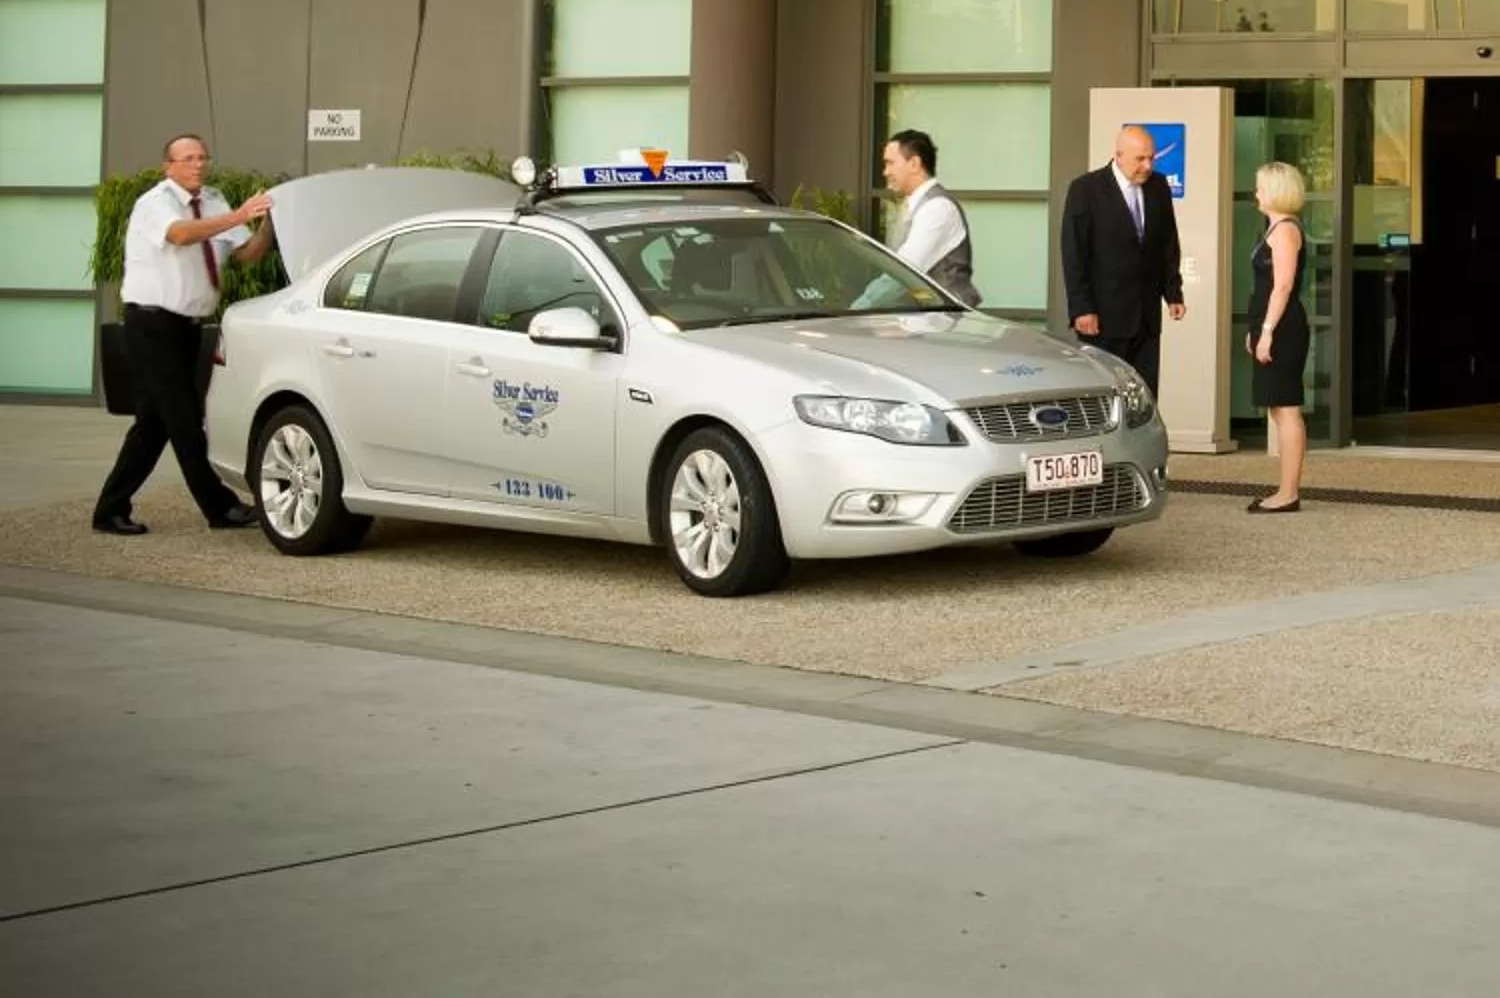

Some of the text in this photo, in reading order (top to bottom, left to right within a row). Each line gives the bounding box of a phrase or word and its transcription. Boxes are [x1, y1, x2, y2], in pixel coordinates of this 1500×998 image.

[327, 113, 343, 124] NO
[313, 126, 355, 137] PARKING
[594, 167, 724, 183] Silver Service
[492, 380, 559, 403] Silver Service
